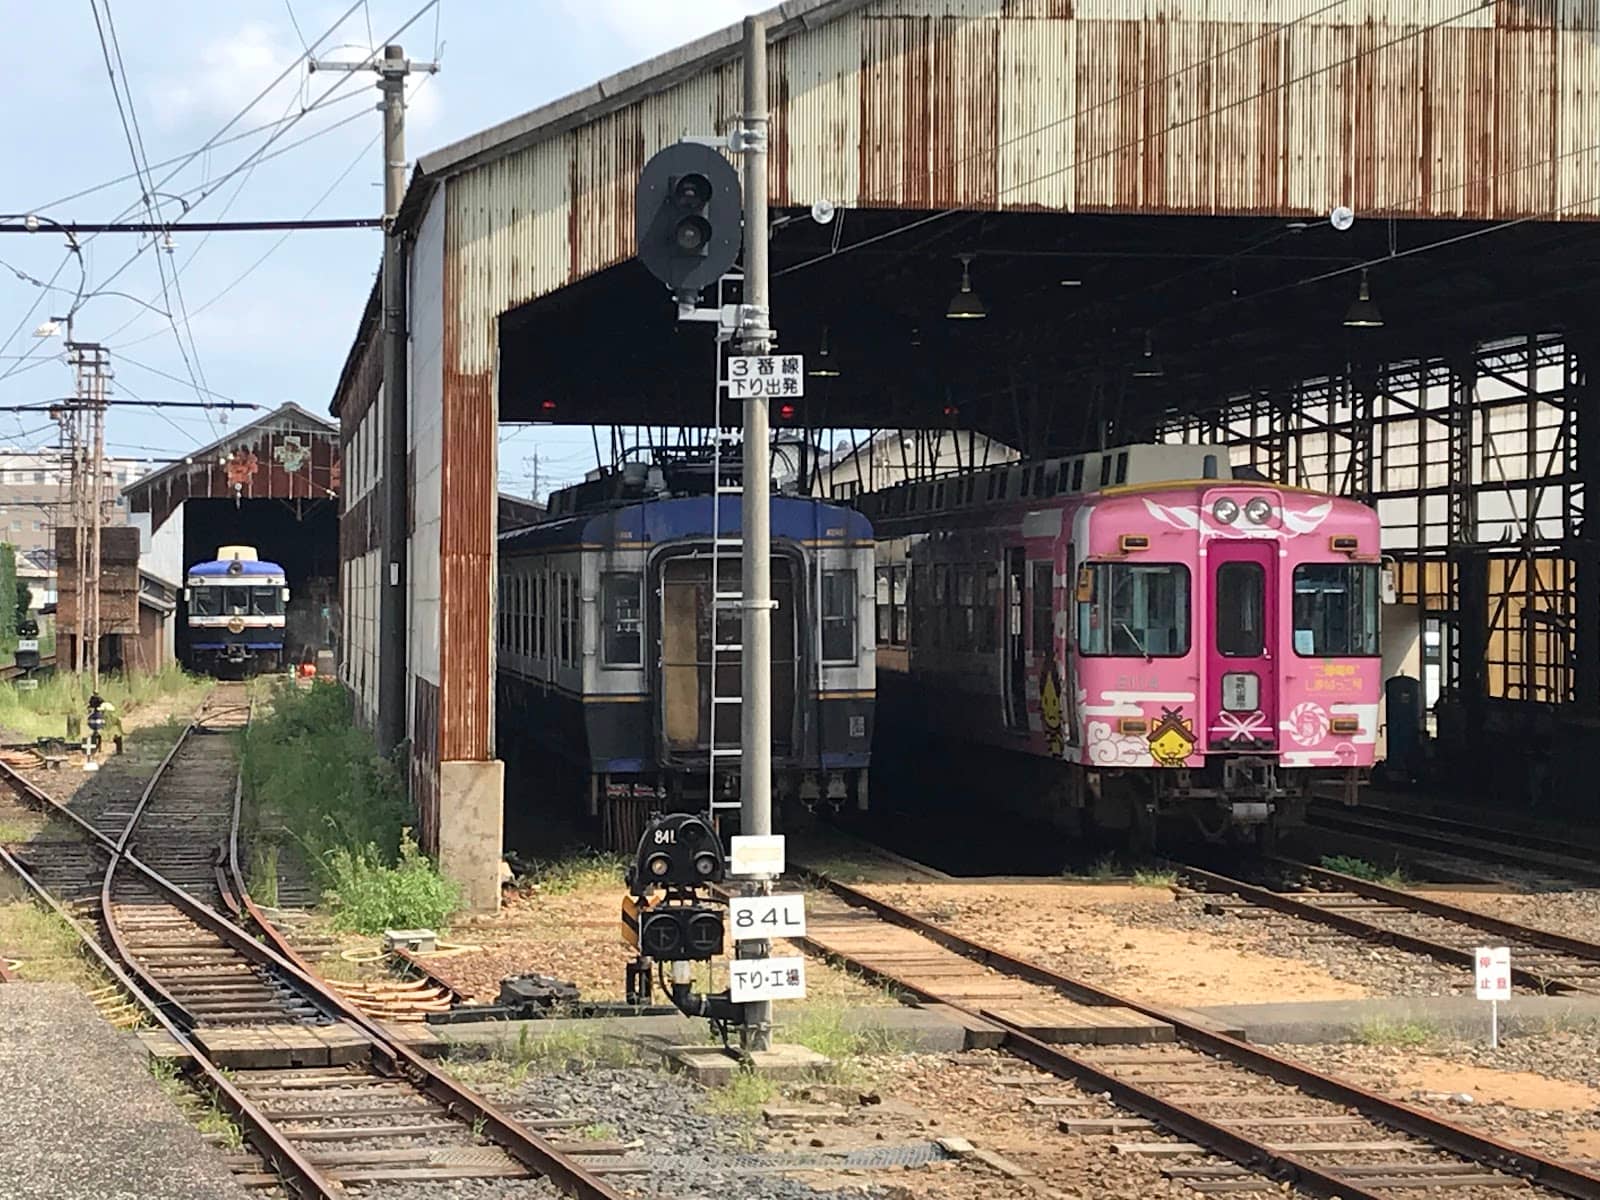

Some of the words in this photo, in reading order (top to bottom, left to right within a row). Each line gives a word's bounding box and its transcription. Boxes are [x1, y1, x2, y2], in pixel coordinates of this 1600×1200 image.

[733, 357, 799, 376] 3番線
[732, 377, 798, 396] 下り出発
[654, 829, 677, 844] 84L
[736, 907, 800, 927] 84L
